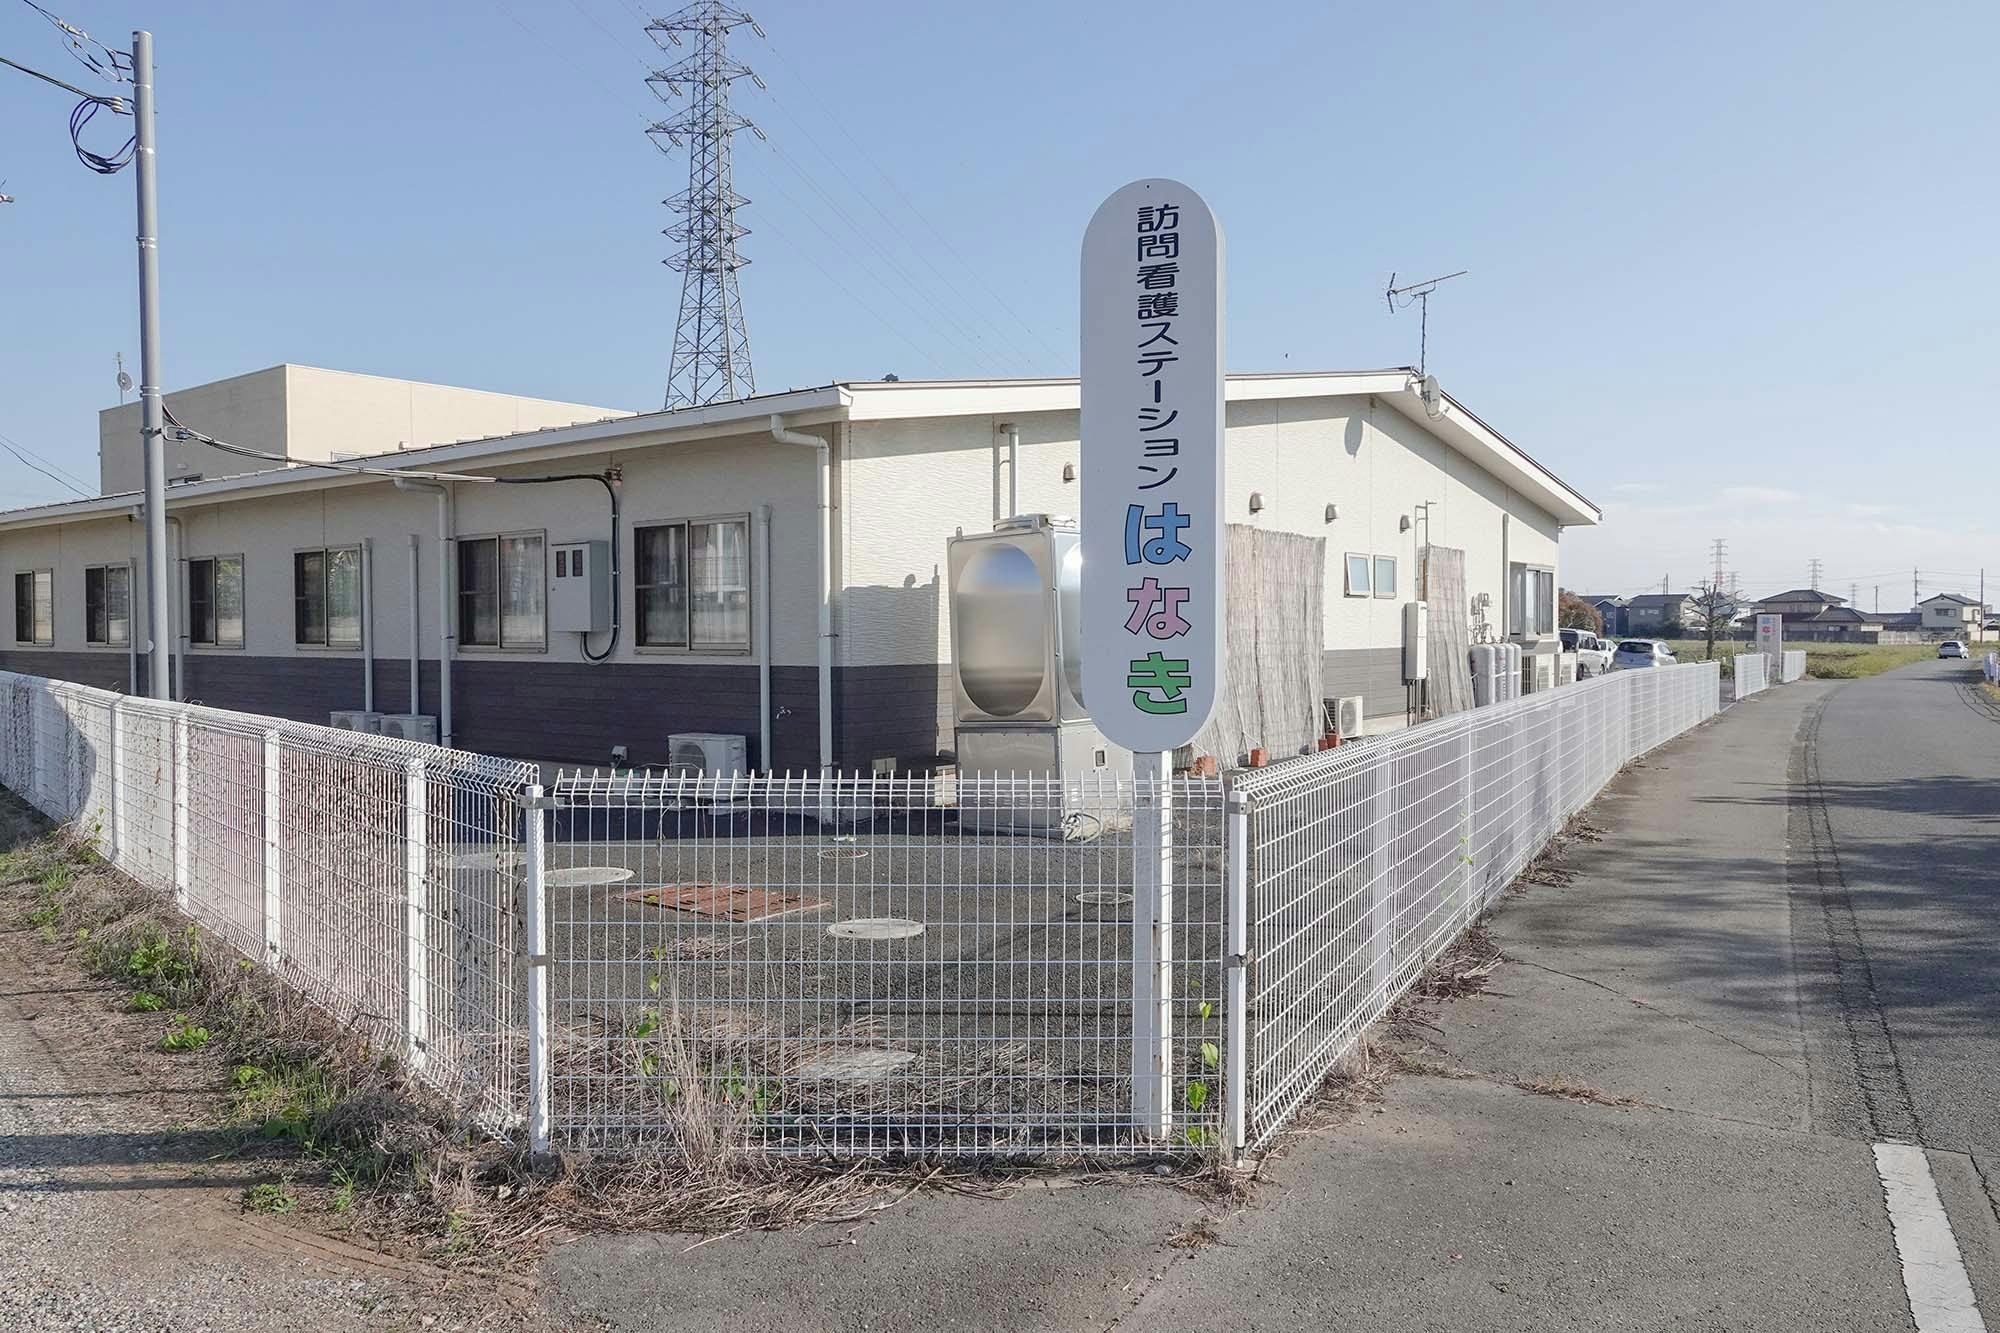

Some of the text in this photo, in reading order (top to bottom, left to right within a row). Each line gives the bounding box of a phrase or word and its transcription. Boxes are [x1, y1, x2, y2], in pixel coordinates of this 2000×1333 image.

[1136, 203, 1180, 490] 訪問看護ステーション
[1124, 502, 1193, 715] はなき
